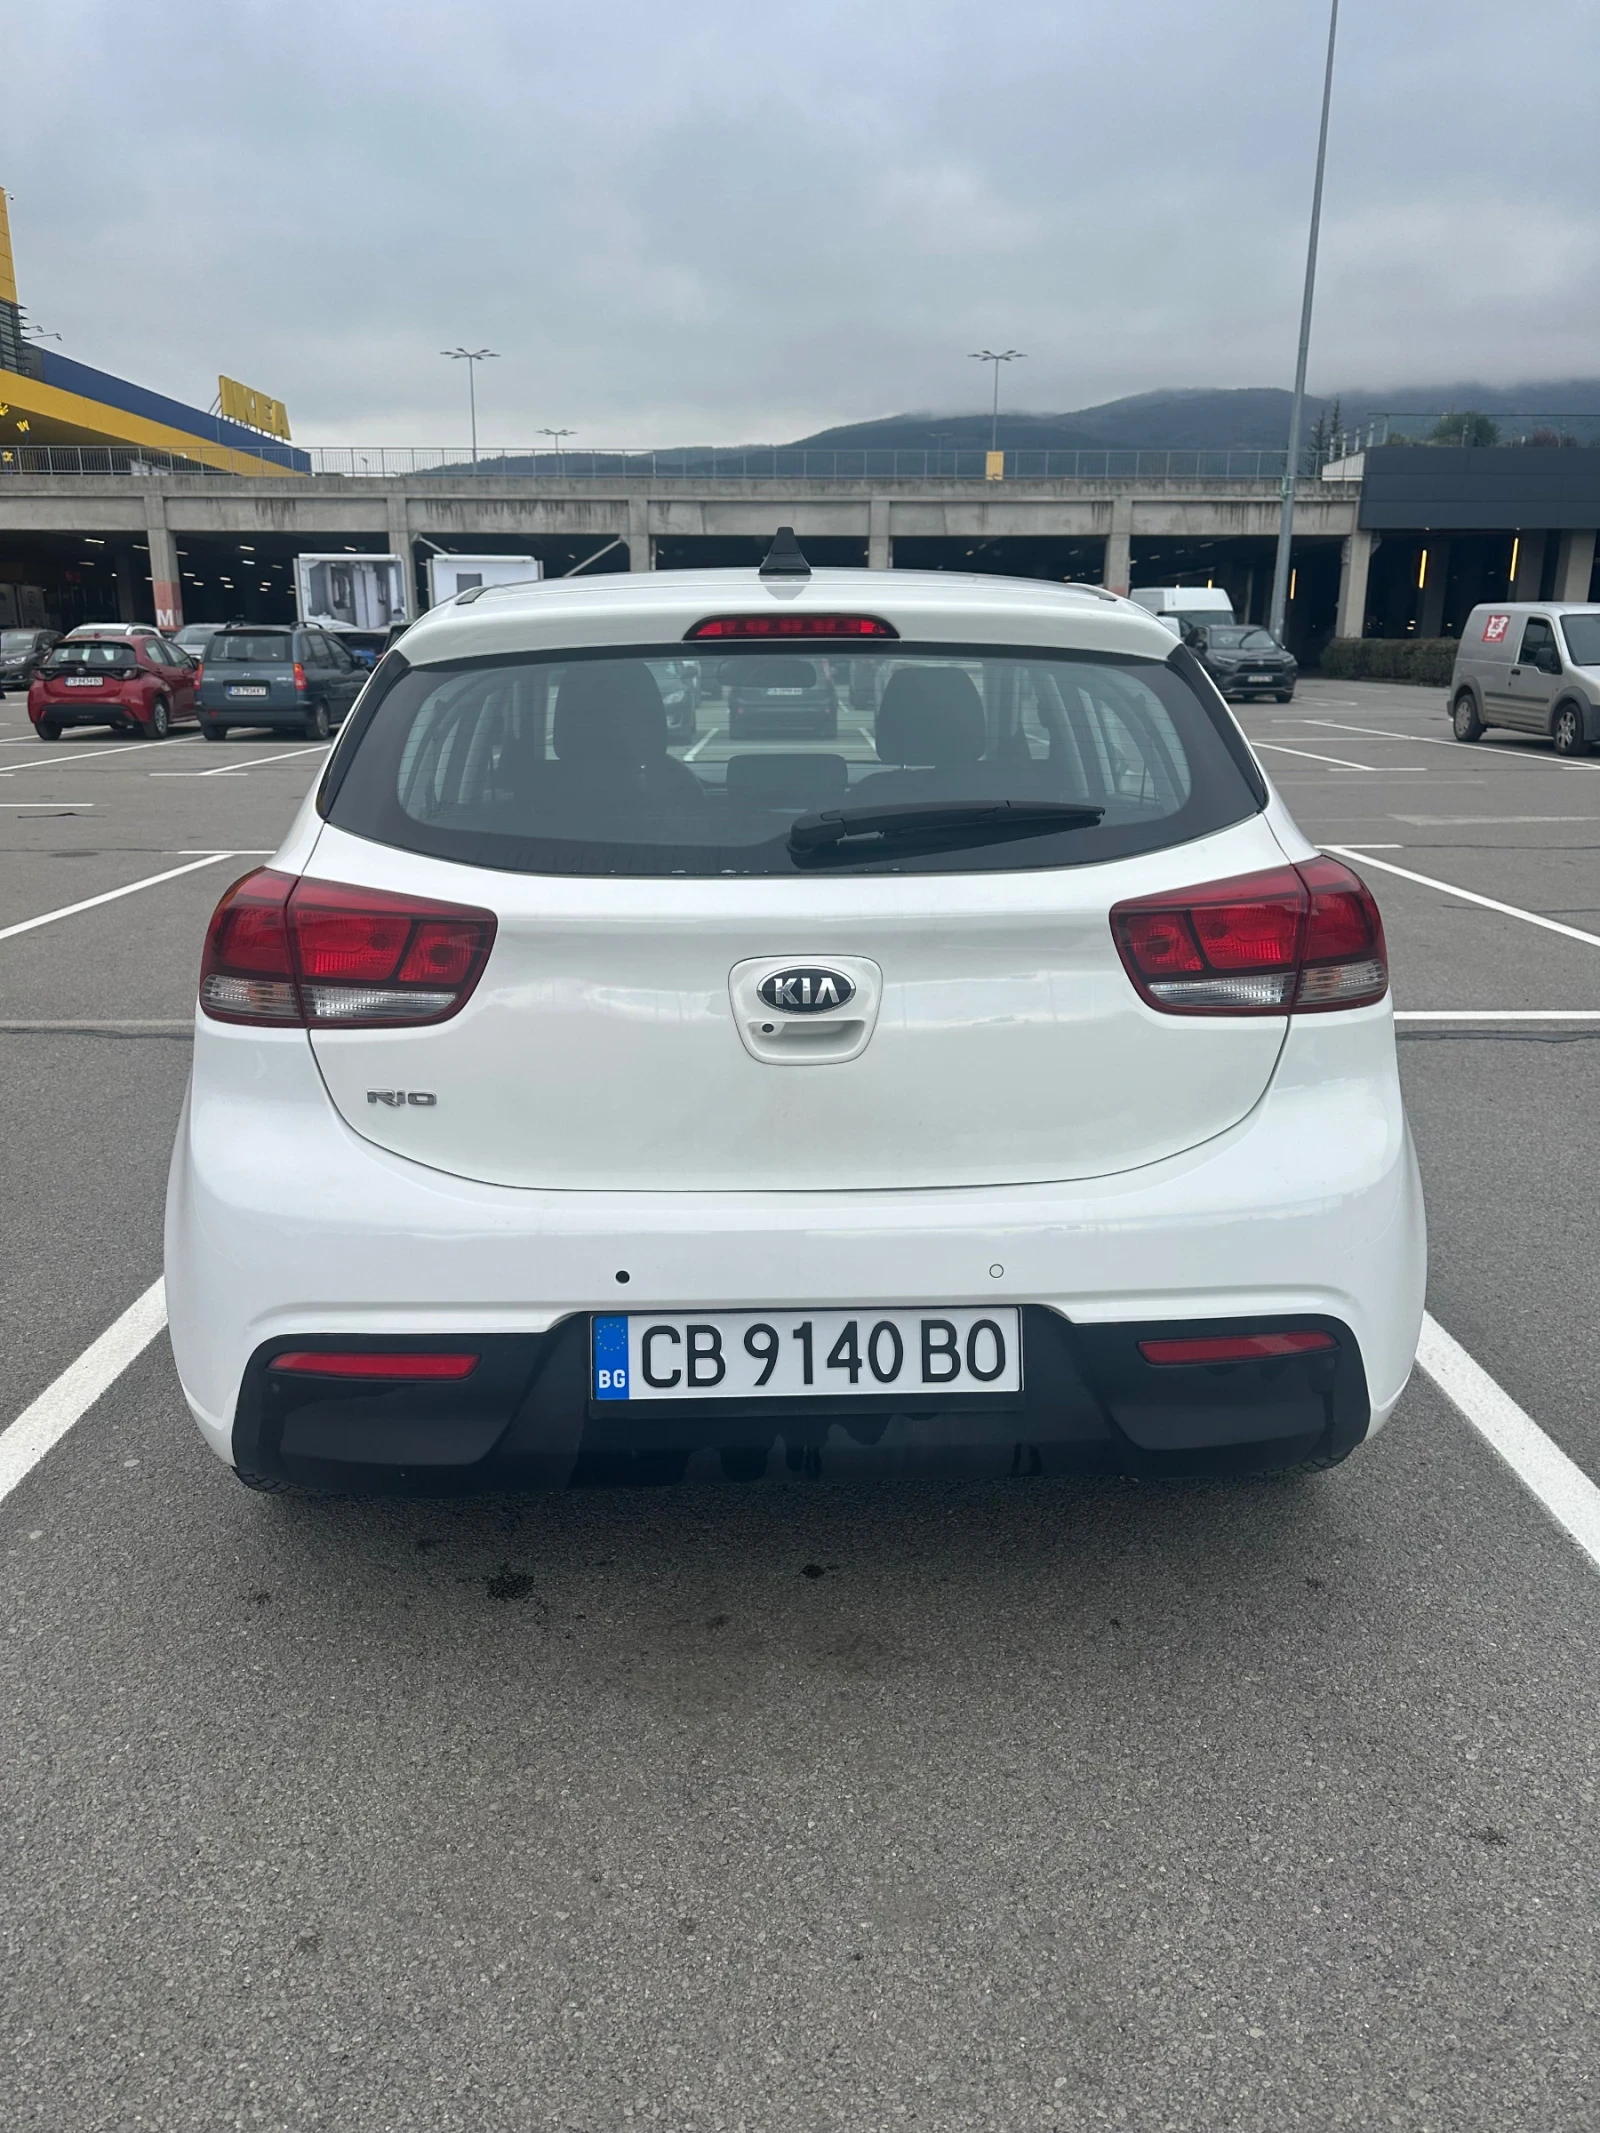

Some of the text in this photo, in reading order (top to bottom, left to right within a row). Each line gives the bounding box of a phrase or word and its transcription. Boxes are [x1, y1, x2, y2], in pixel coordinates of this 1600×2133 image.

[219, 375, 292, 441] IKEA
[156, 608, 174, 627] M
[774, 977, 840, 1004] KIA
[367, 1088, 438, 1107] RIO
[641, 1318, 1006, 1388] CB 9140 BO
[598, 1369, 626, 1389] BG
